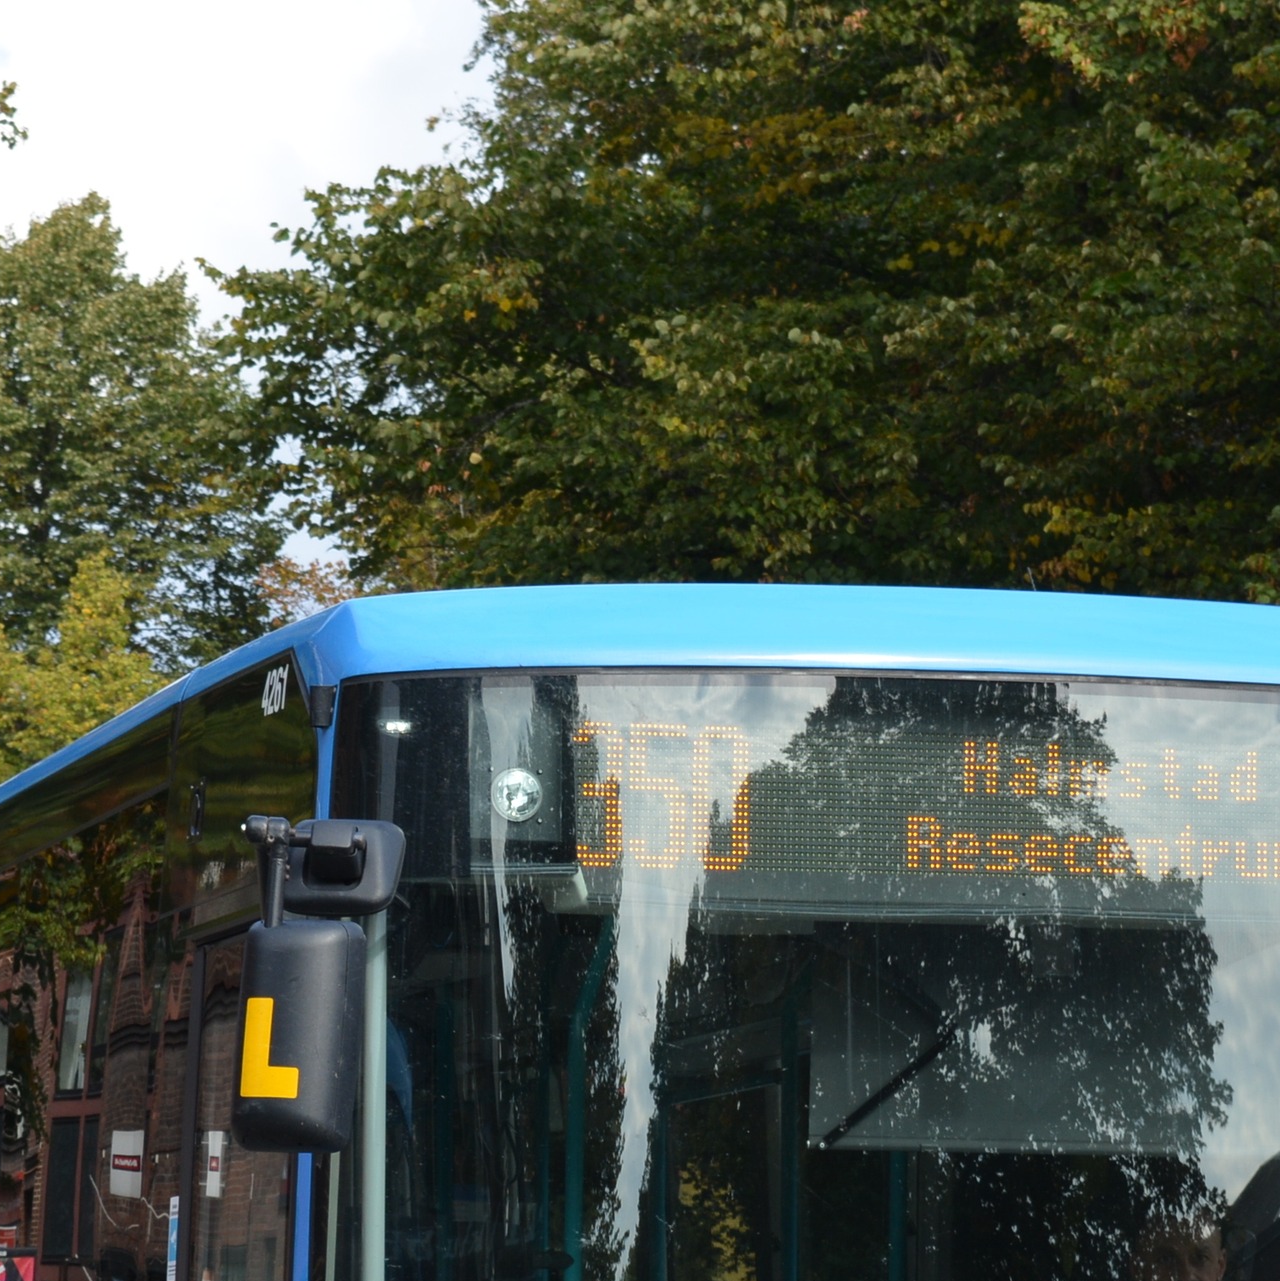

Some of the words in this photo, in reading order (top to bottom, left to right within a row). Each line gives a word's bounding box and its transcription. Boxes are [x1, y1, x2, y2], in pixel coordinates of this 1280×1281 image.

[261, 663, 289, 717] 4261
[572, 720, 750, 871] 350
[962, 740, 1259, 802] Halmstad
